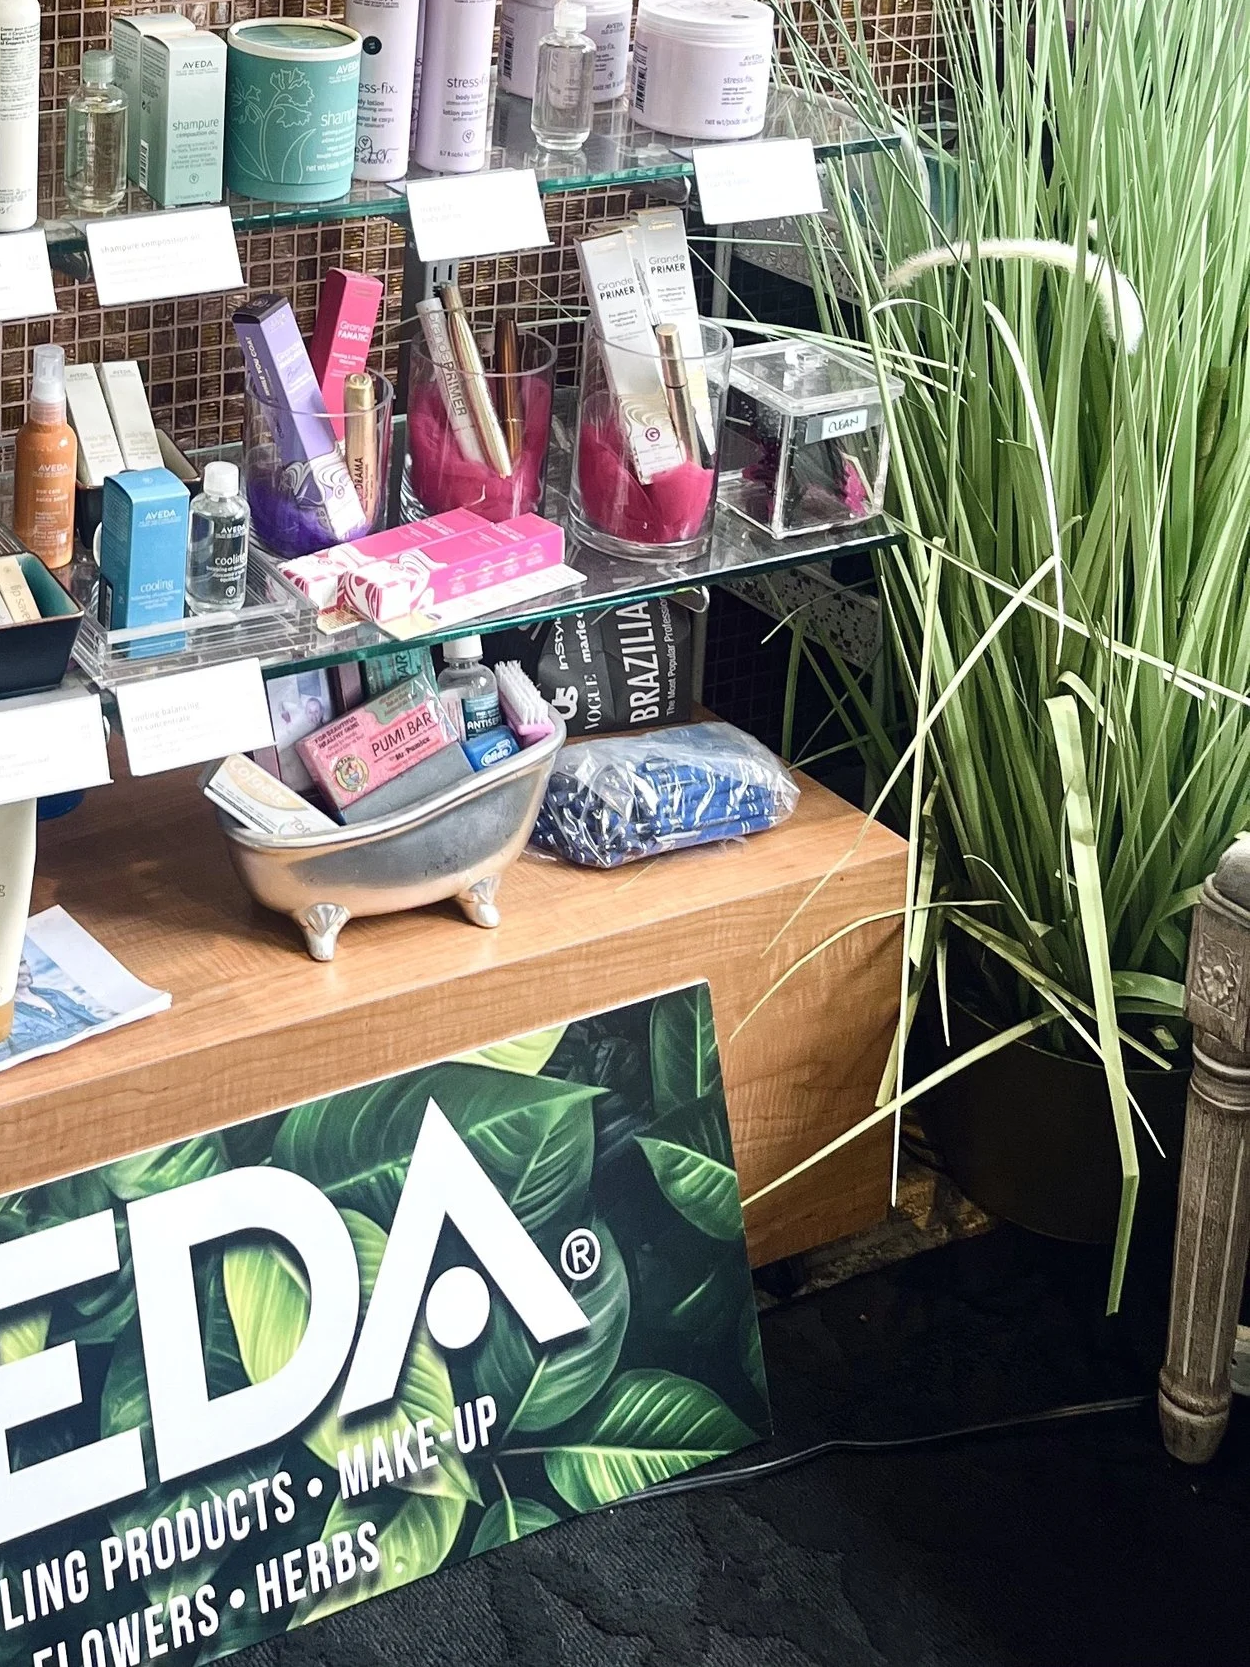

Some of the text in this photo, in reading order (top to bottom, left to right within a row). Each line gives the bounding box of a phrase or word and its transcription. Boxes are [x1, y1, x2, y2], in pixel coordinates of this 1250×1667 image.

[172, 117, 220, 132] shampure
[649, 253, 685, 266] Grande
[651, 263, 686, 275] PRIMER
[597, 276, 634, 291] Grande
[600, 286, 636, 300] PRIMER
[339, 321, 371, 332] Grande
[337, 330, 369, 342] FANATIC
[827, 416, 859, 433] CLEAN
[666, 644, 678, 716] The Most Popular
[371, 712, 433, 757] PUMI BAR
[230, 758, 289, 804] Colgate
[101, 1472, 296, 1593] PRODUCTS
[336, 1395, 499, 1501] MAKE-UP
[255, 1520, 382, 1615] HERBS
